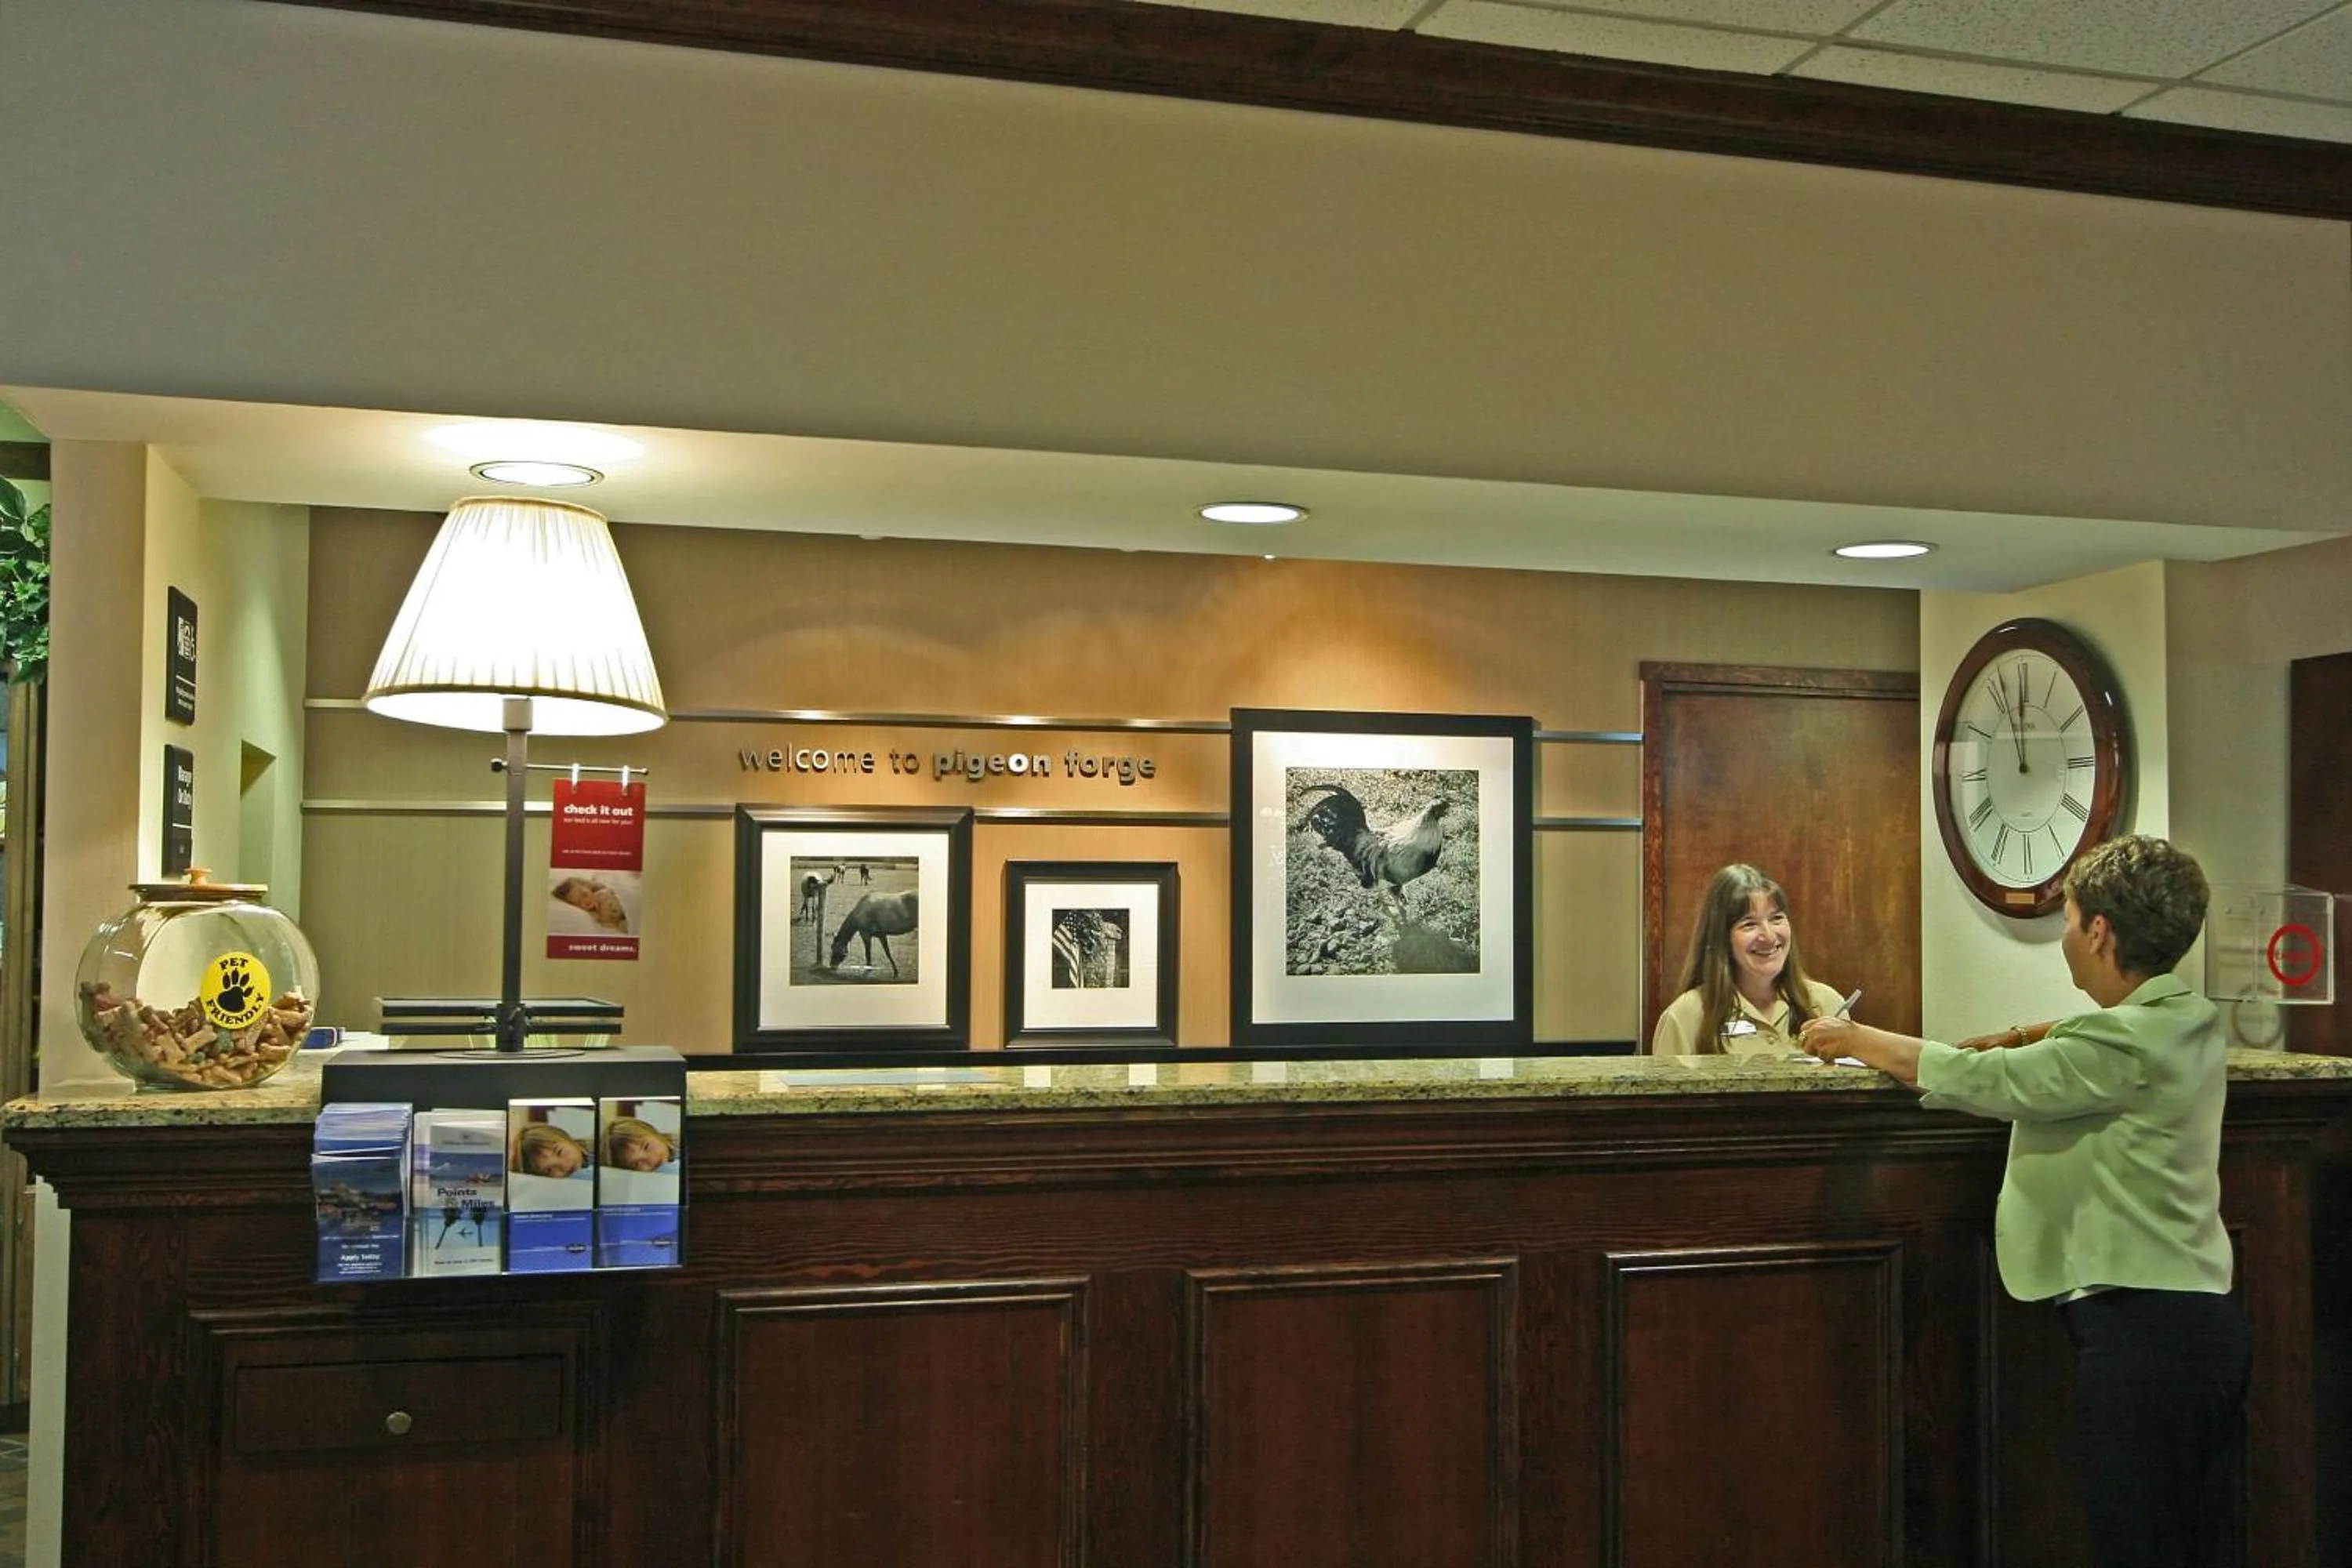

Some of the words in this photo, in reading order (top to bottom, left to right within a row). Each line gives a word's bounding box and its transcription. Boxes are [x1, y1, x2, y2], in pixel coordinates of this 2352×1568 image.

[740, 743, 876, 773] welcome
[889, 749, 920, 775] to
[933, 749, 1051, 782] pigeon
[1064, 750, 1156, 785] forge
[564, 804, 597, 815] check
[600, 804, 610, 815] it
[612, 807, 633, 816] out
[568, 943, 597, 952] sweet
[220, 957, 249, 971] PET
[205, 992, 264, 1025] FRIENDLY
[437, 1187, 477, 1197] Points
